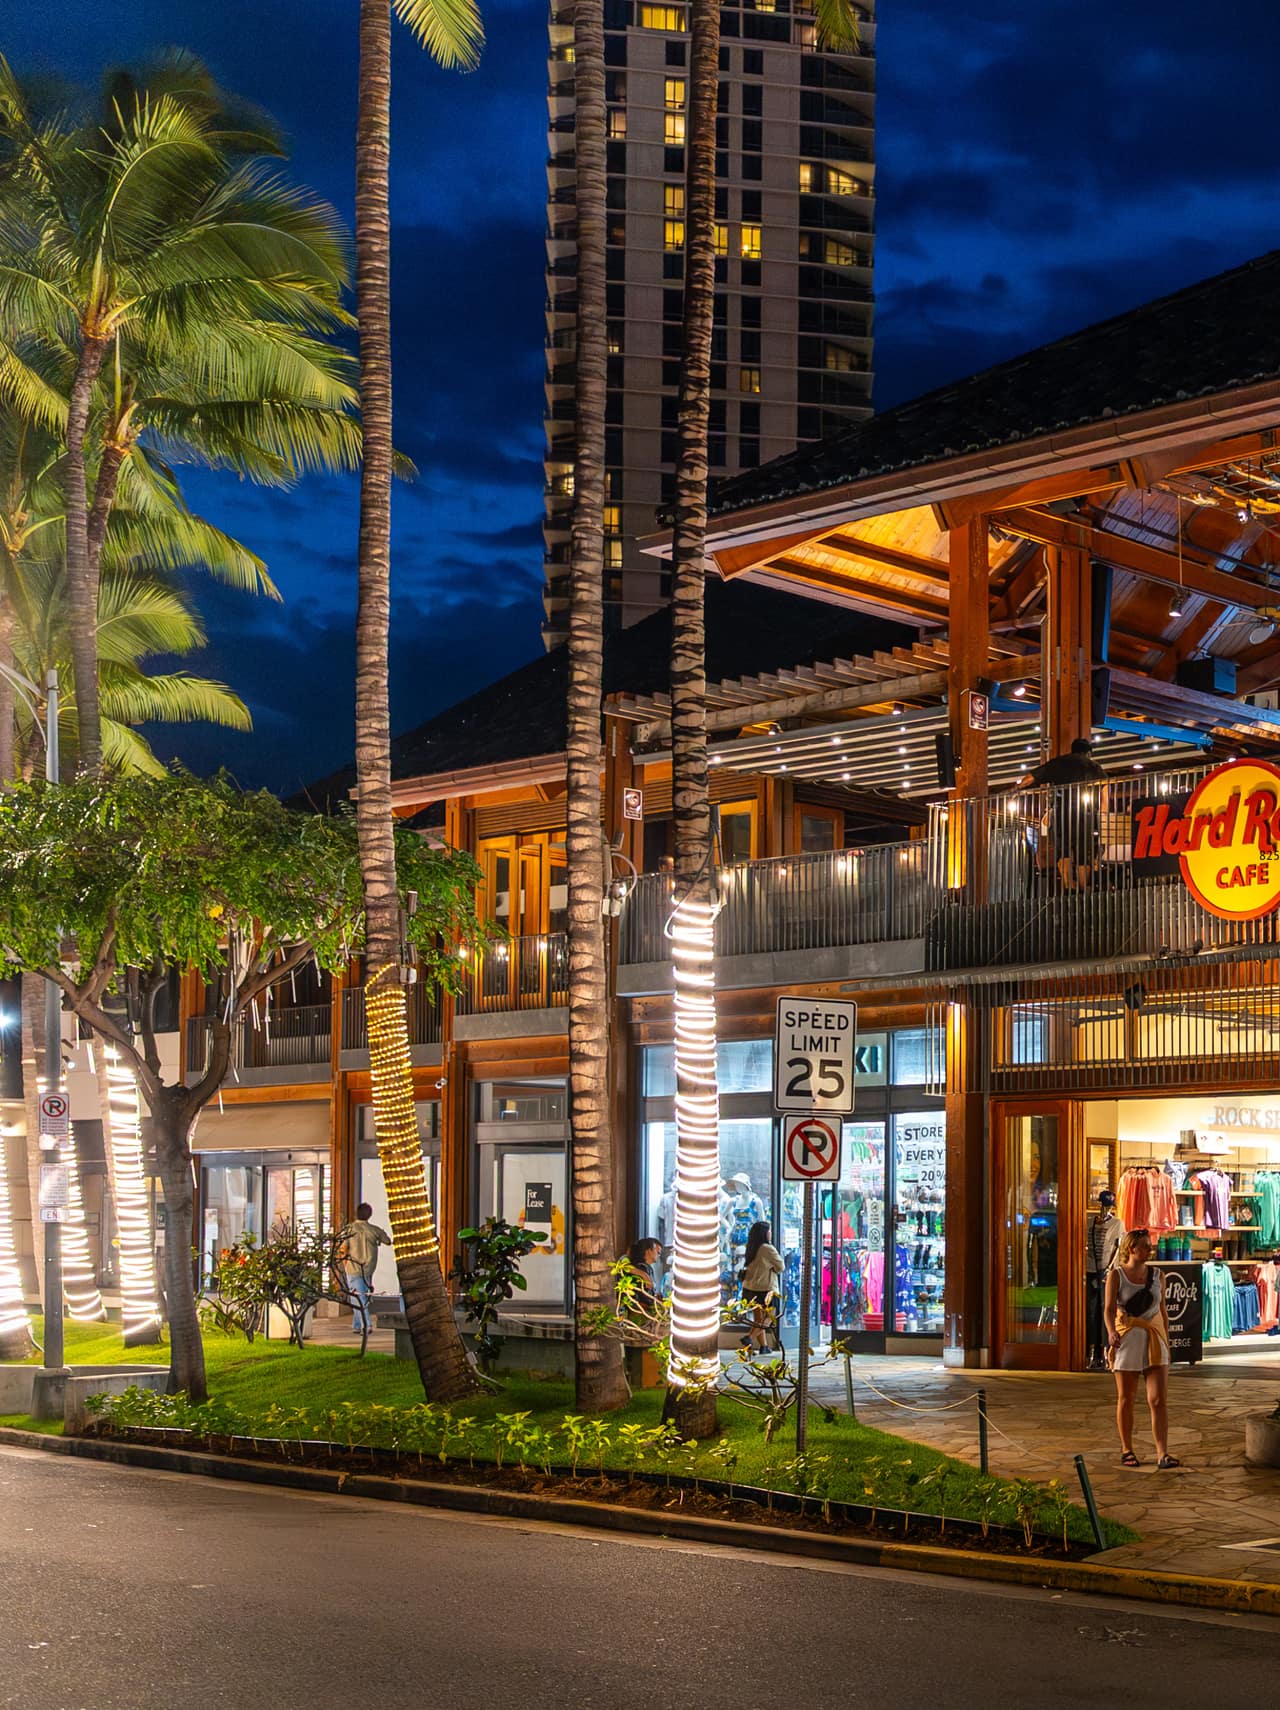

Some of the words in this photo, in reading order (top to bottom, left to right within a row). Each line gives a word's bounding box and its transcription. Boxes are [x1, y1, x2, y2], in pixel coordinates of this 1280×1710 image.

[1133, 792, 1241, 859] Hard
[1215, 862, 1269, 889] CAFE
[784, 1011, 849, 1031] SPEED
[791, 1034, 841, 1053] LIMIT
[785, 1057, 845, 1099] 25
[1214, 1105, 1260, 1127] ROCK
[904, 1126, 943, 1141] STORE
[526, 1199, 545, 1208] Lease
[527, 1189, 537, 1199] For
[1173, 1282, 1198, 1302] Rock
